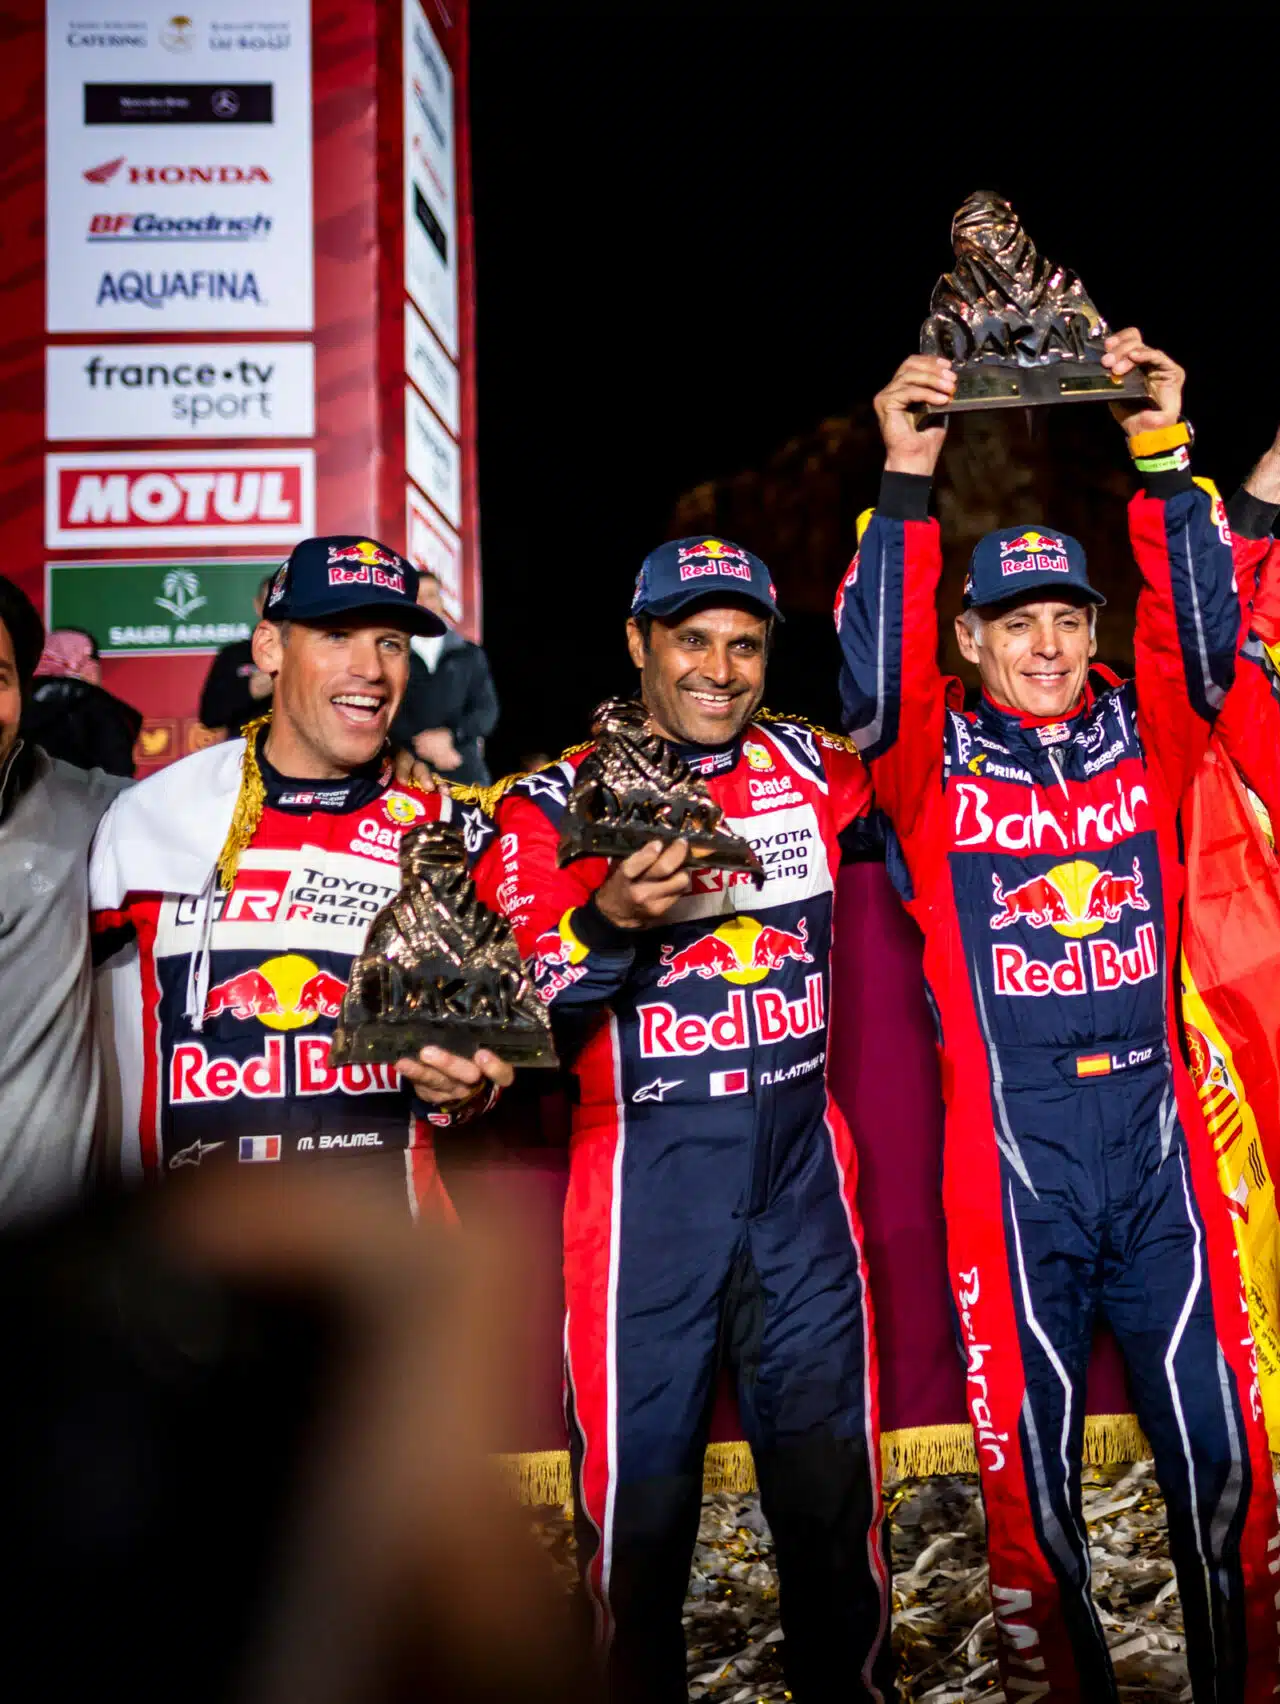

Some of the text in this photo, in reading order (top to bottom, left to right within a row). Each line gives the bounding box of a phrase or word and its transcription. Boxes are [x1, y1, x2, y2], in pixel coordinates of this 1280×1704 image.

[128, 165, 272, 184] HONDA
[89, 212, 272, 235] BFGoodrich
[96, 269, 262, 309] AQUAFINA
[172, 392, 272, 427] sport
[67, 472, 294, 524] MOTUL
[680, 560, 752, 581] Red Bull
[1002, 554, 1069, 576] Red Bull
[328, 566, 406, 594] Red Bull
[109, 622, 251, 645] SAUDI ARABIA
[985, 760, 1035, 785] PRIMA
[954, 778, 1149, 851] Bahrain
[358, 818, 400, 847] Qat
[747, 828, 813, 851] OYOTA
[757, 846, 808, 866] ZOO
[303, 867, 399, 899] TOYOT
[294, 886, 380, 914] GAZO
[285, 903, 372, 928] Racin
[992, 922, 1158, 998] Red Bull
[637, 972, 825, 1059] Red Bull
[169, 1035, 286, 1105] Red
[1112, 1046, 1153, 1069] L. Cruz
[297, 1132, 384, 1151] M. BAUMEL
